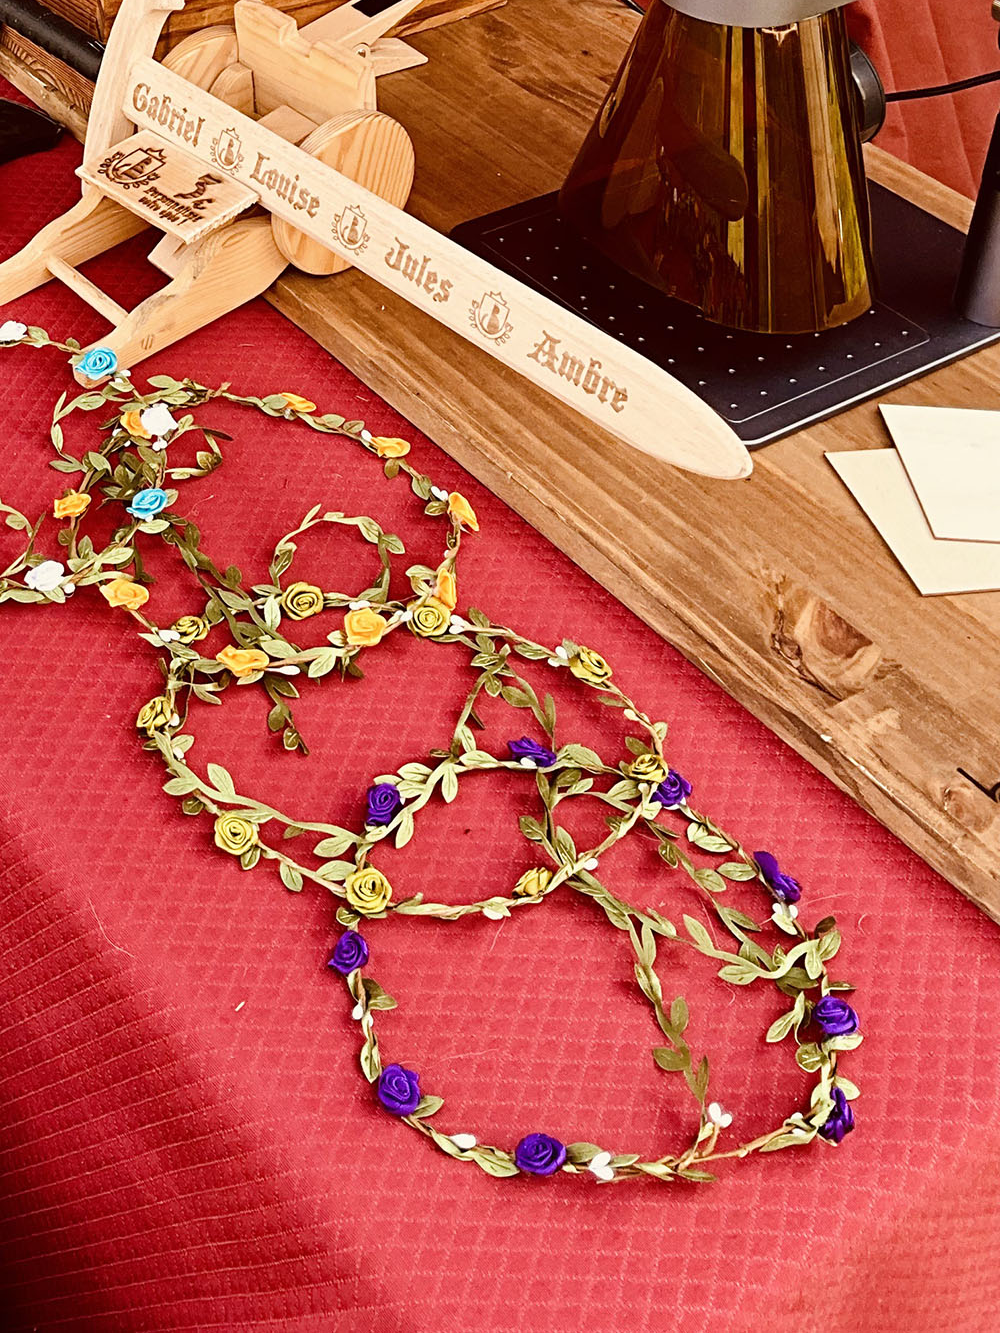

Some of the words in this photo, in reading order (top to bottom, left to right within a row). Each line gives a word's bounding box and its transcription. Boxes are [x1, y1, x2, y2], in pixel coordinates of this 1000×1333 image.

[132, 83, 206, 147] Gabriel
[250, 152, 321, 218] Louise
[384, 236, 454, 304] Jules
[527, 329, 629, 413] Ambre
